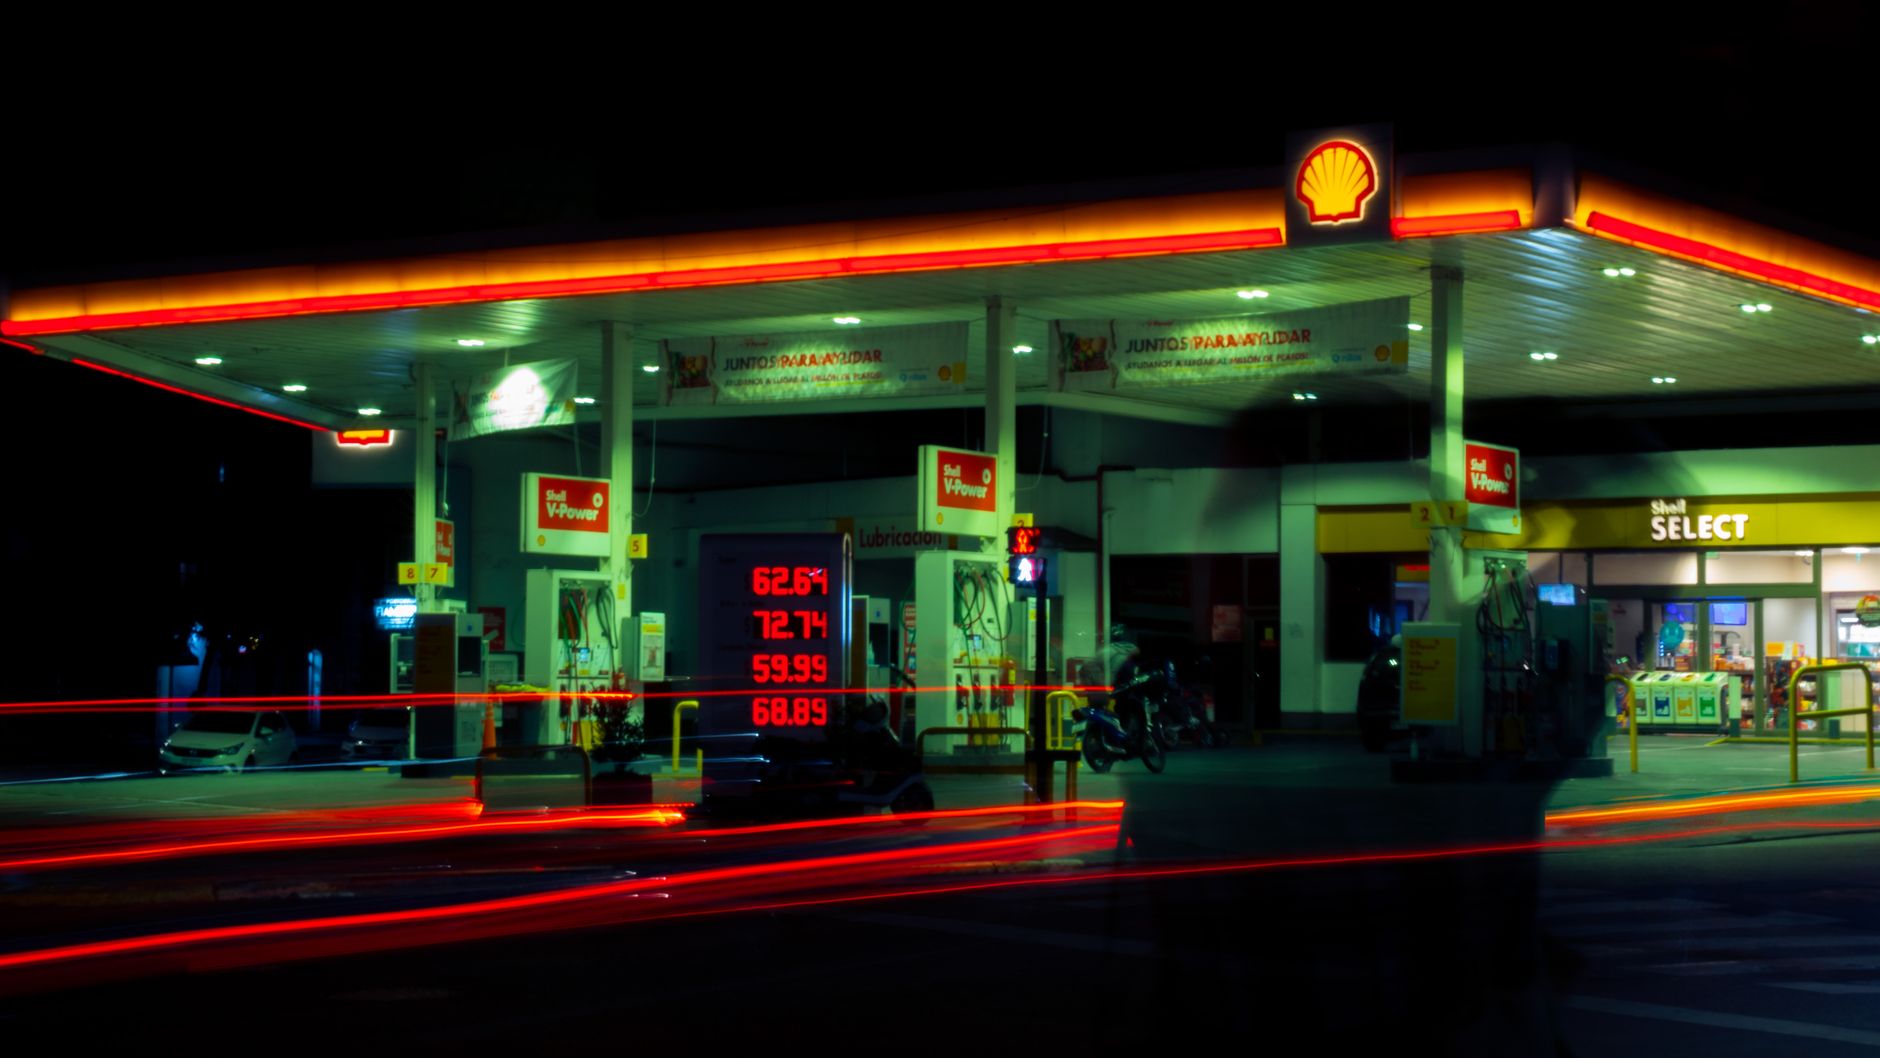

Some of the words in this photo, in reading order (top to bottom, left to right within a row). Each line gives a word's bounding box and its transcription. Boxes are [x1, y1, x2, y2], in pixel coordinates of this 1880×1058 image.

[1125, 336, 1188, 353] JUNTOS
[1191, 333, 1238, 350] PARA
[1240, 328, 1311, 347] AYUDAR
[724, 355, 776, 371] JUNTOS
[778, 354, 818, 368] PARA
[546, 489, 566, 501] Shell
[943, 477, 988, 499] V-Power
[546, 502, 599, 521] V-Power
[1420, 507, 1430, 521] 2
[1650, 498, 1687, 515] Shell
[1651, 514, 1749, 541] SELECT
[632, 540, 640, 552] 5
[407, 567, 415, 580] 8
[430, 567, 438, 579] 7
[753, 567, 828, 596] 62.64
[753, 610, 828, 640] 72.74
[753, 654, 828, 684] 59.99
[753, 697, 828, 727] 68.89
